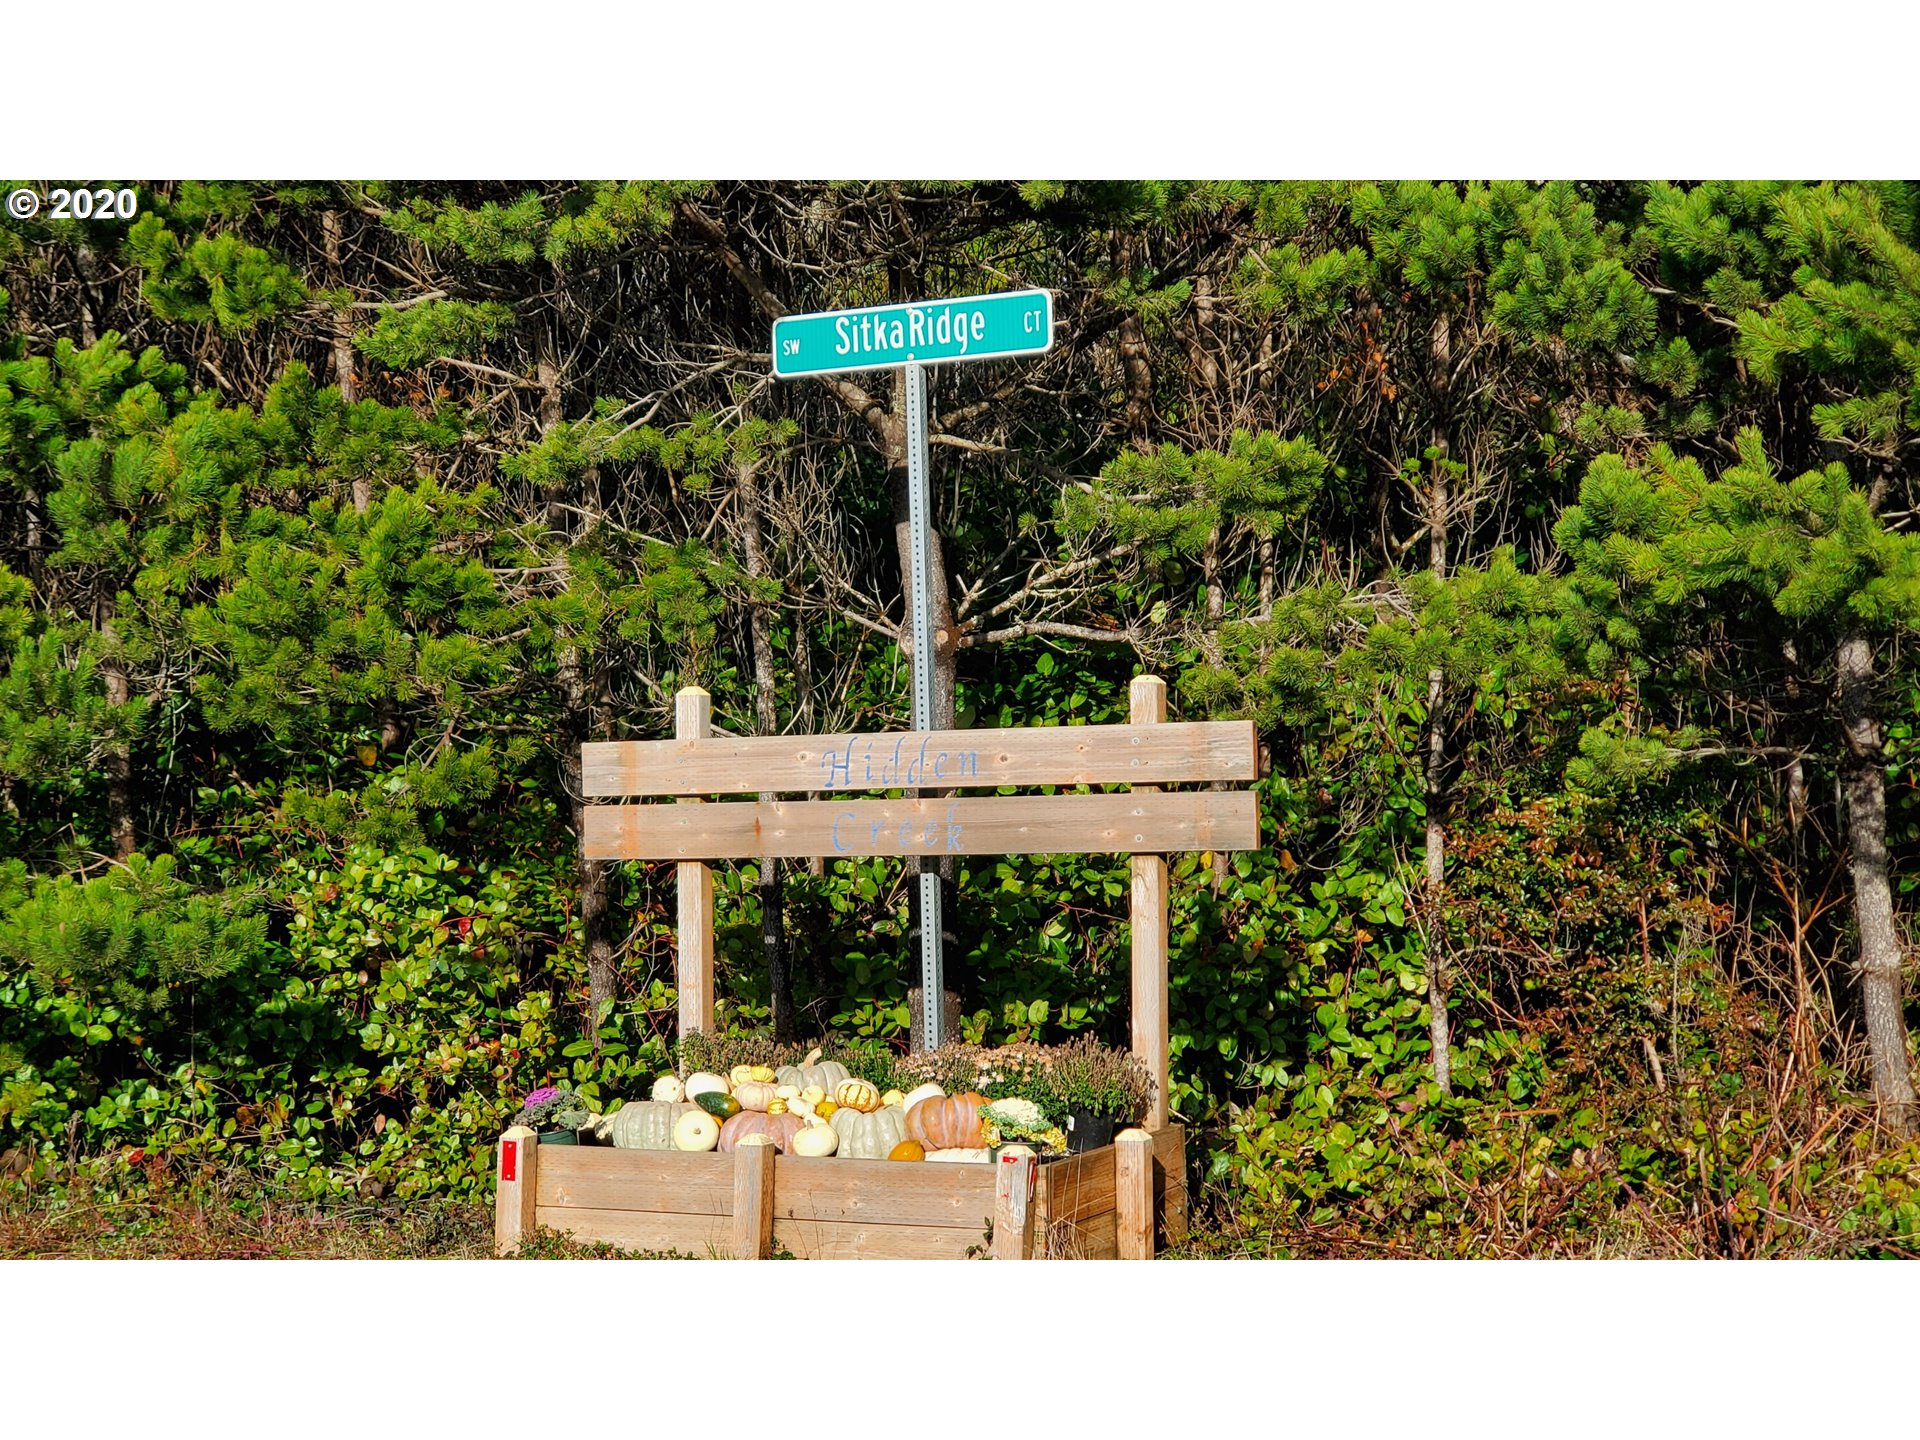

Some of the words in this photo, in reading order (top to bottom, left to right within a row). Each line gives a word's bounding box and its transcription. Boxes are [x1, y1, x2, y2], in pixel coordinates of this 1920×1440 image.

[783, 338, 800, 356] SW
[1024, 310, 1042, 333] CT
[820, 736, 978, 788] Hidden
[832, 801, 964, 853] Creek
